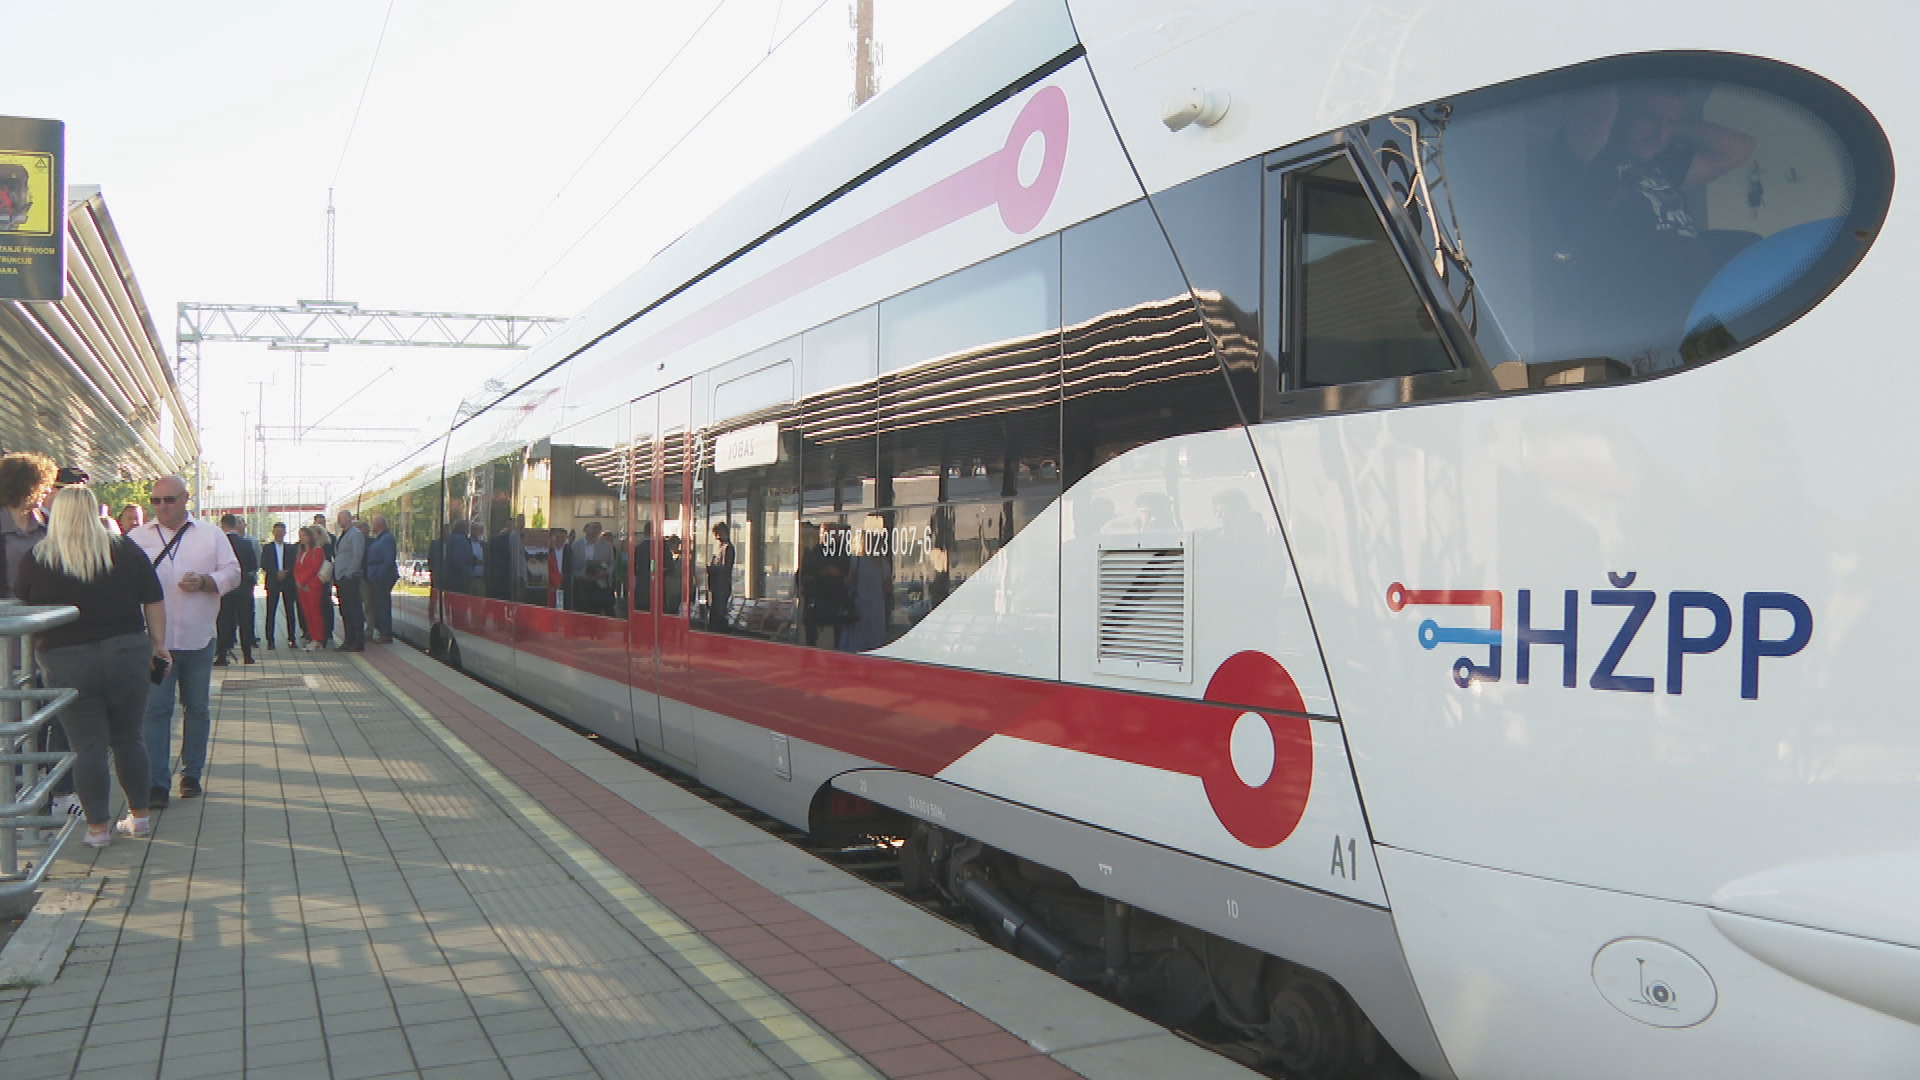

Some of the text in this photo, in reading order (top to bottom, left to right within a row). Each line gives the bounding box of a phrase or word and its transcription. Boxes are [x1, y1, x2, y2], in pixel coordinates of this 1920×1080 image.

[23, 246, 55, 254] PRUGOM
[865, 528, 888, 556] 023
[1515, 571, 1814, 700] HŽPP
[1330, 834, 1357, 881] A1
